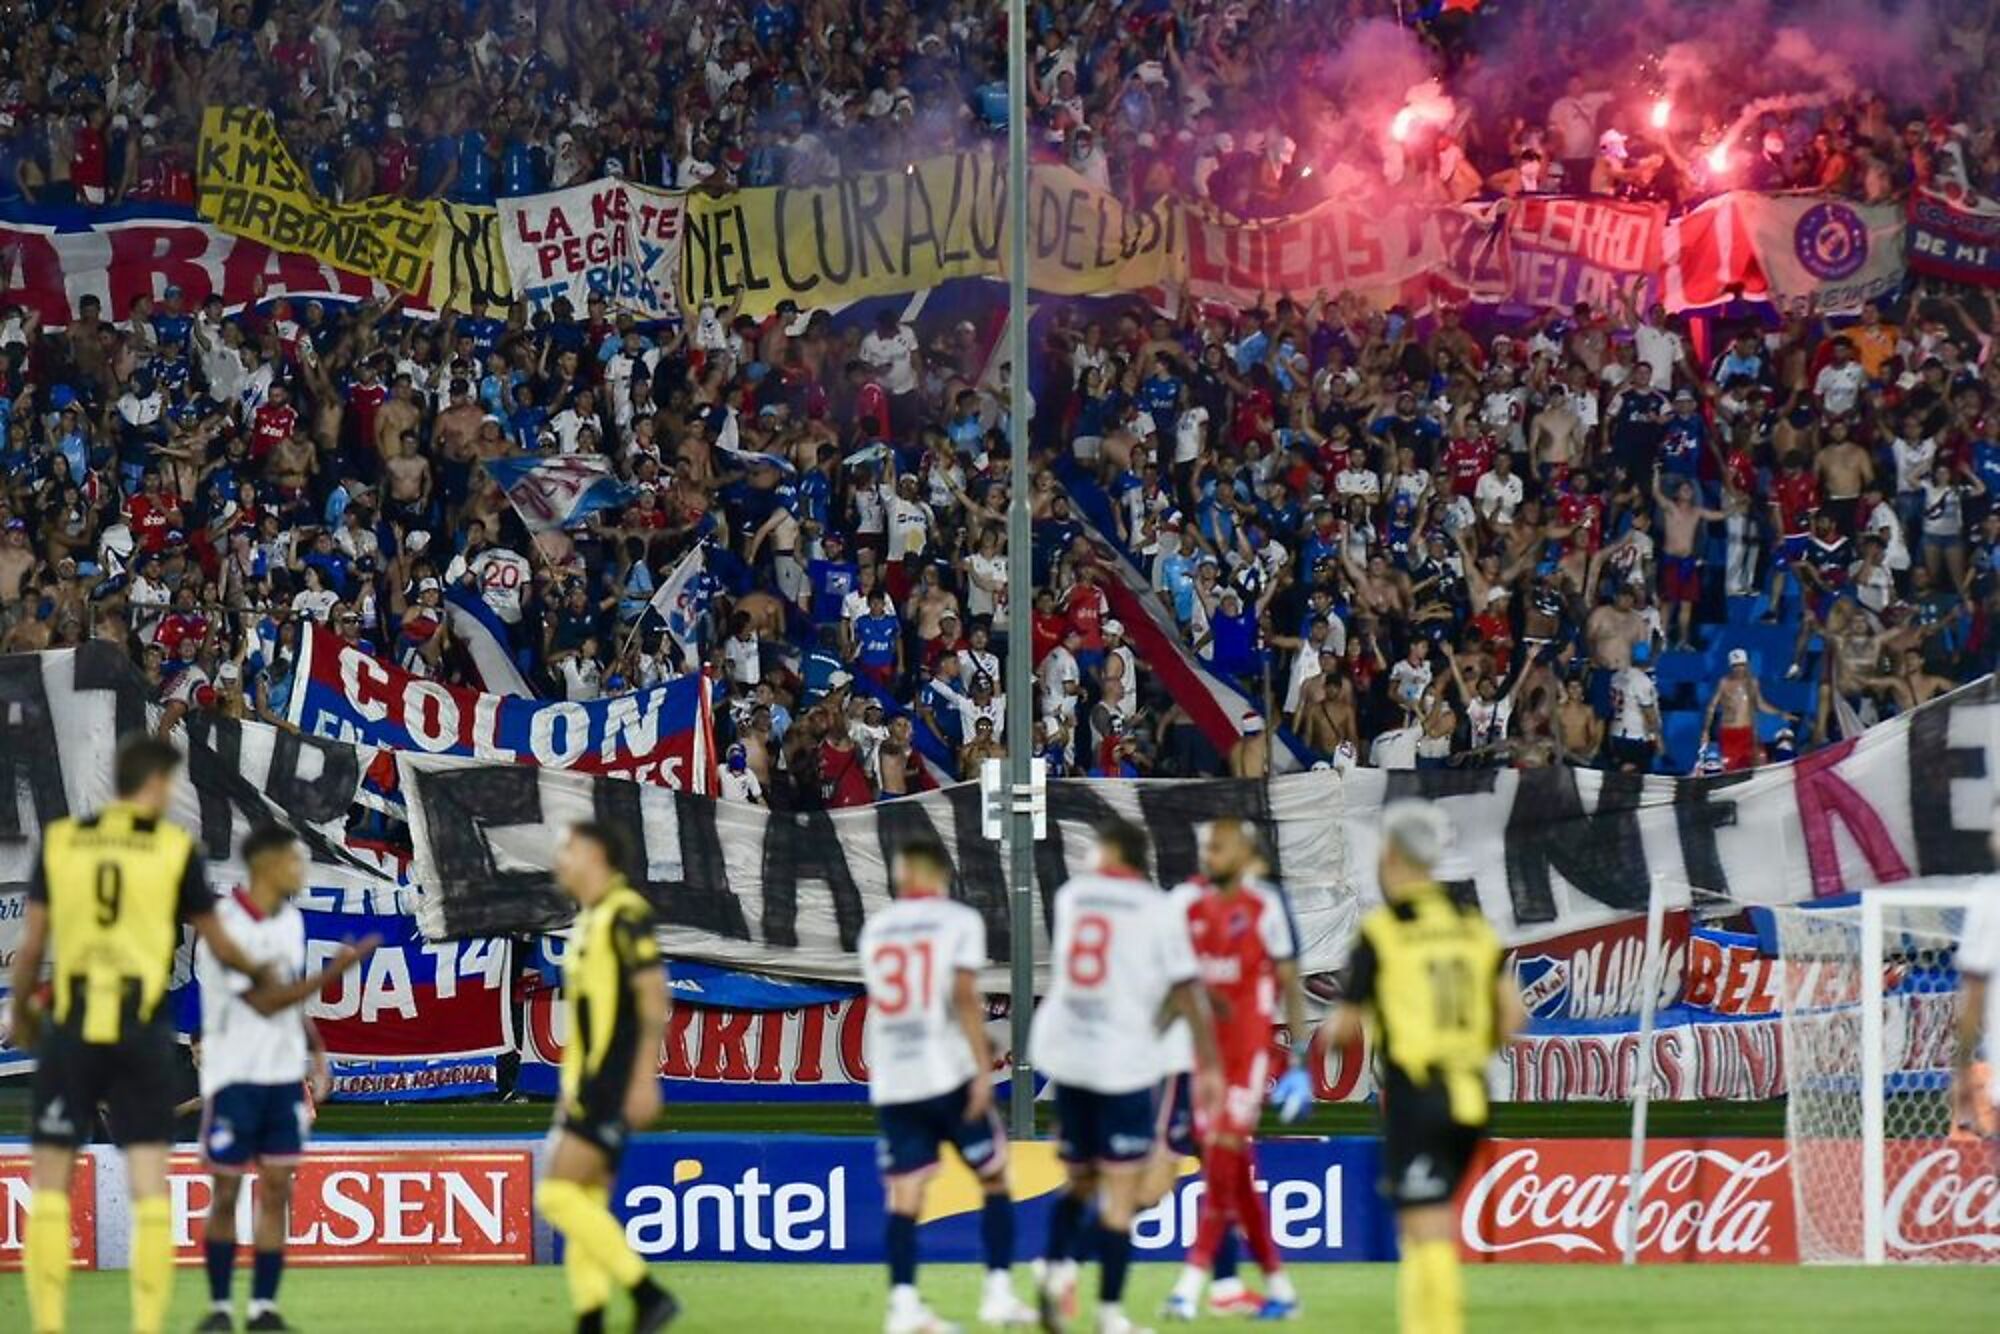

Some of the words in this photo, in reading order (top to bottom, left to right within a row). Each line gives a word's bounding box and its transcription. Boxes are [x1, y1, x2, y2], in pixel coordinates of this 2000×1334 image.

[517, 208, 572, 243] LA
[640, 203, 680, 239] TE
[538, 225, 625, 279] PEGA
[1184, 207, 1385, 290] LUCAS
[1913, 230, 1946, 256] DE
[1955, 245, 1988, 264] MI
[482, 561, 520, 589] 20
[338, 646, 667, 768] COLON
[95, 860, 122, 928] 9
[421, 938, 506, 999] 14
[873, 940, 932, 1015] 31
[1067, 914, 1112, 988] 8
[1501, 1030, 1684, 1101] TODOS
[624, 1159, 846, 1253] antel
[1461, 1148, 1790, 1254] Coca-Cola
